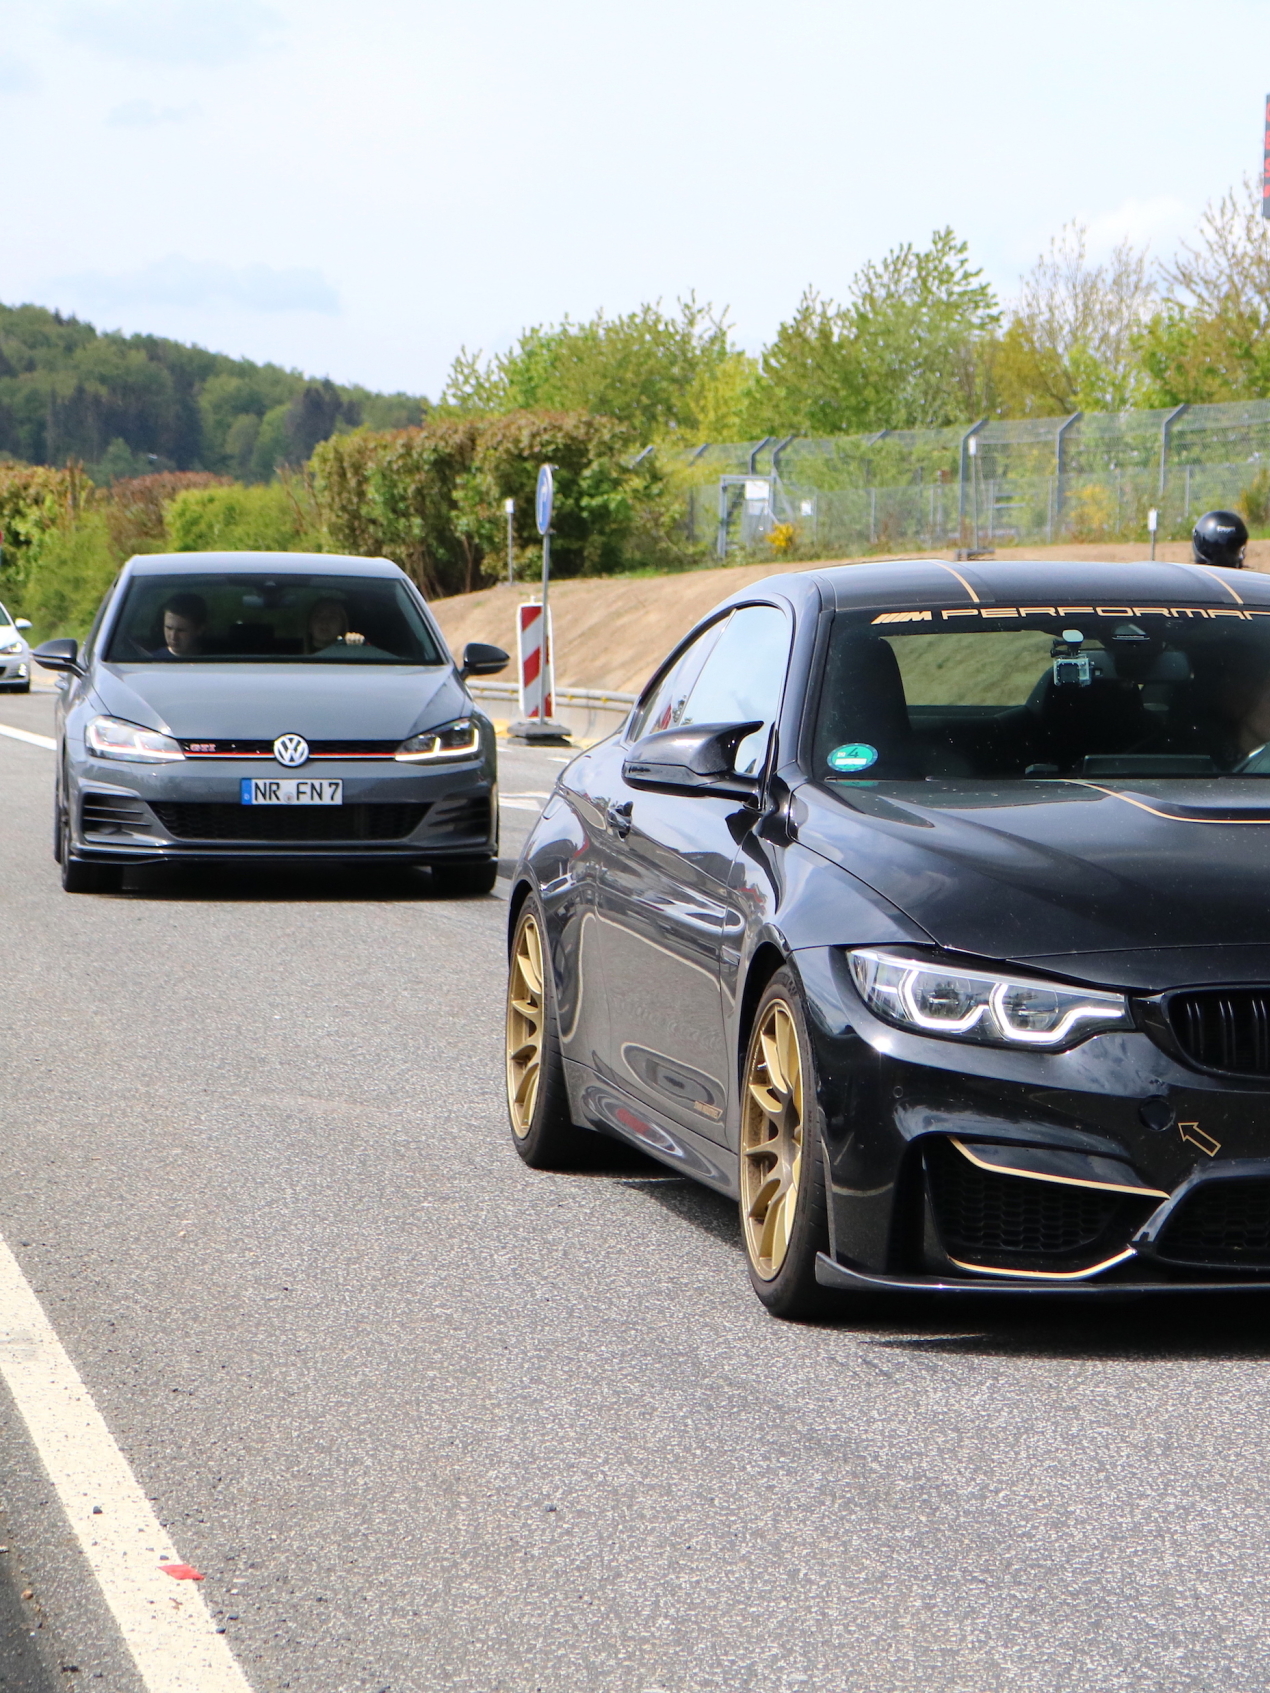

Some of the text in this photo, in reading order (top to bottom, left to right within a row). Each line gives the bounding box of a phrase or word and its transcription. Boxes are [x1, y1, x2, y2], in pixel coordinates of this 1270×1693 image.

[190, 743, 216, 752] GTI
[254, 782, 340, 802] NR FN 7
